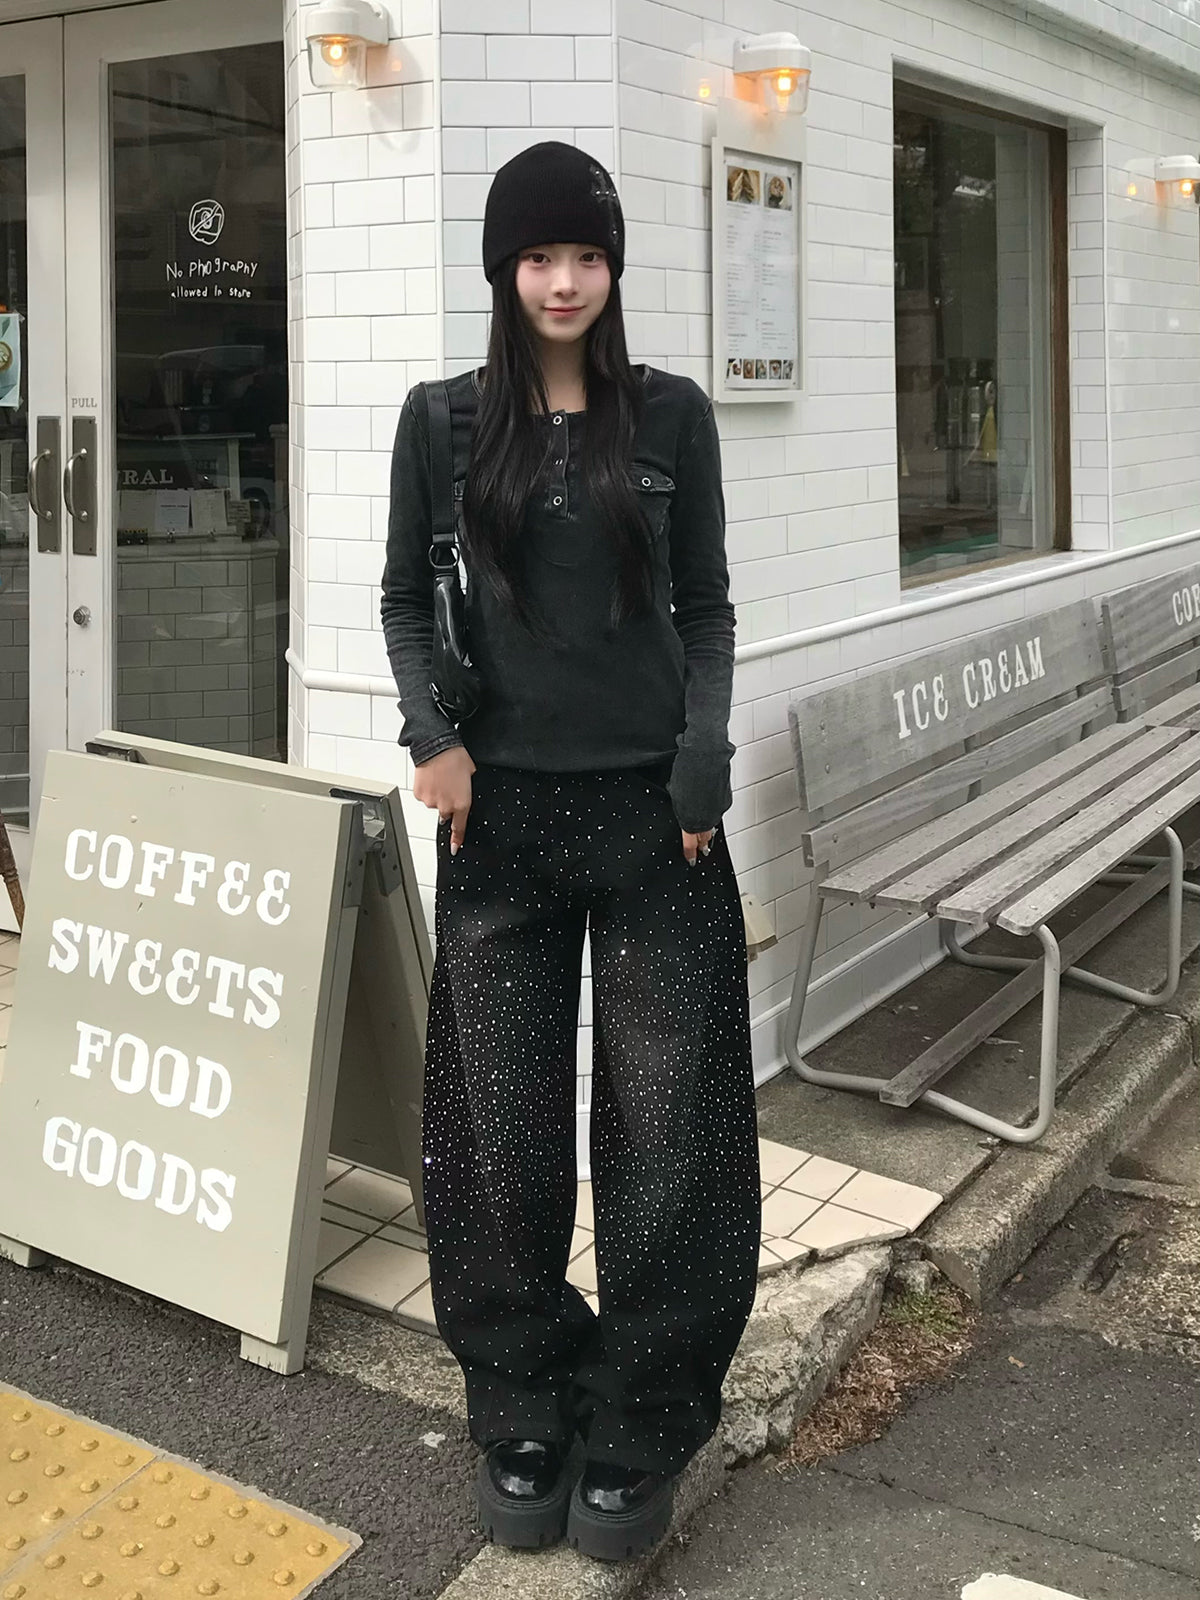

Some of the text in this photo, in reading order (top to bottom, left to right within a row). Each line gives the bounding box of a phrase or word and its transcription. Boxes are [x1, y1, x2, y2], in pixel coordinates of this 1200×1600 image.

[166, 262, 183, 281] No
[171, 285, 208, 298] allowed
[229, 287, 251, 298] store
[71, 397, 97, 408] PULL
[117, 469, 174, 485] RAL
[893, 636, 1046, 739] ICE CREAM
[64, 828, 291, 926] COFFEE
[48, 917, 284, 1030] SWEETS
[70, 1020, 232, 1119] FOOD
[42, 1116, 236, 1233] GOODS
